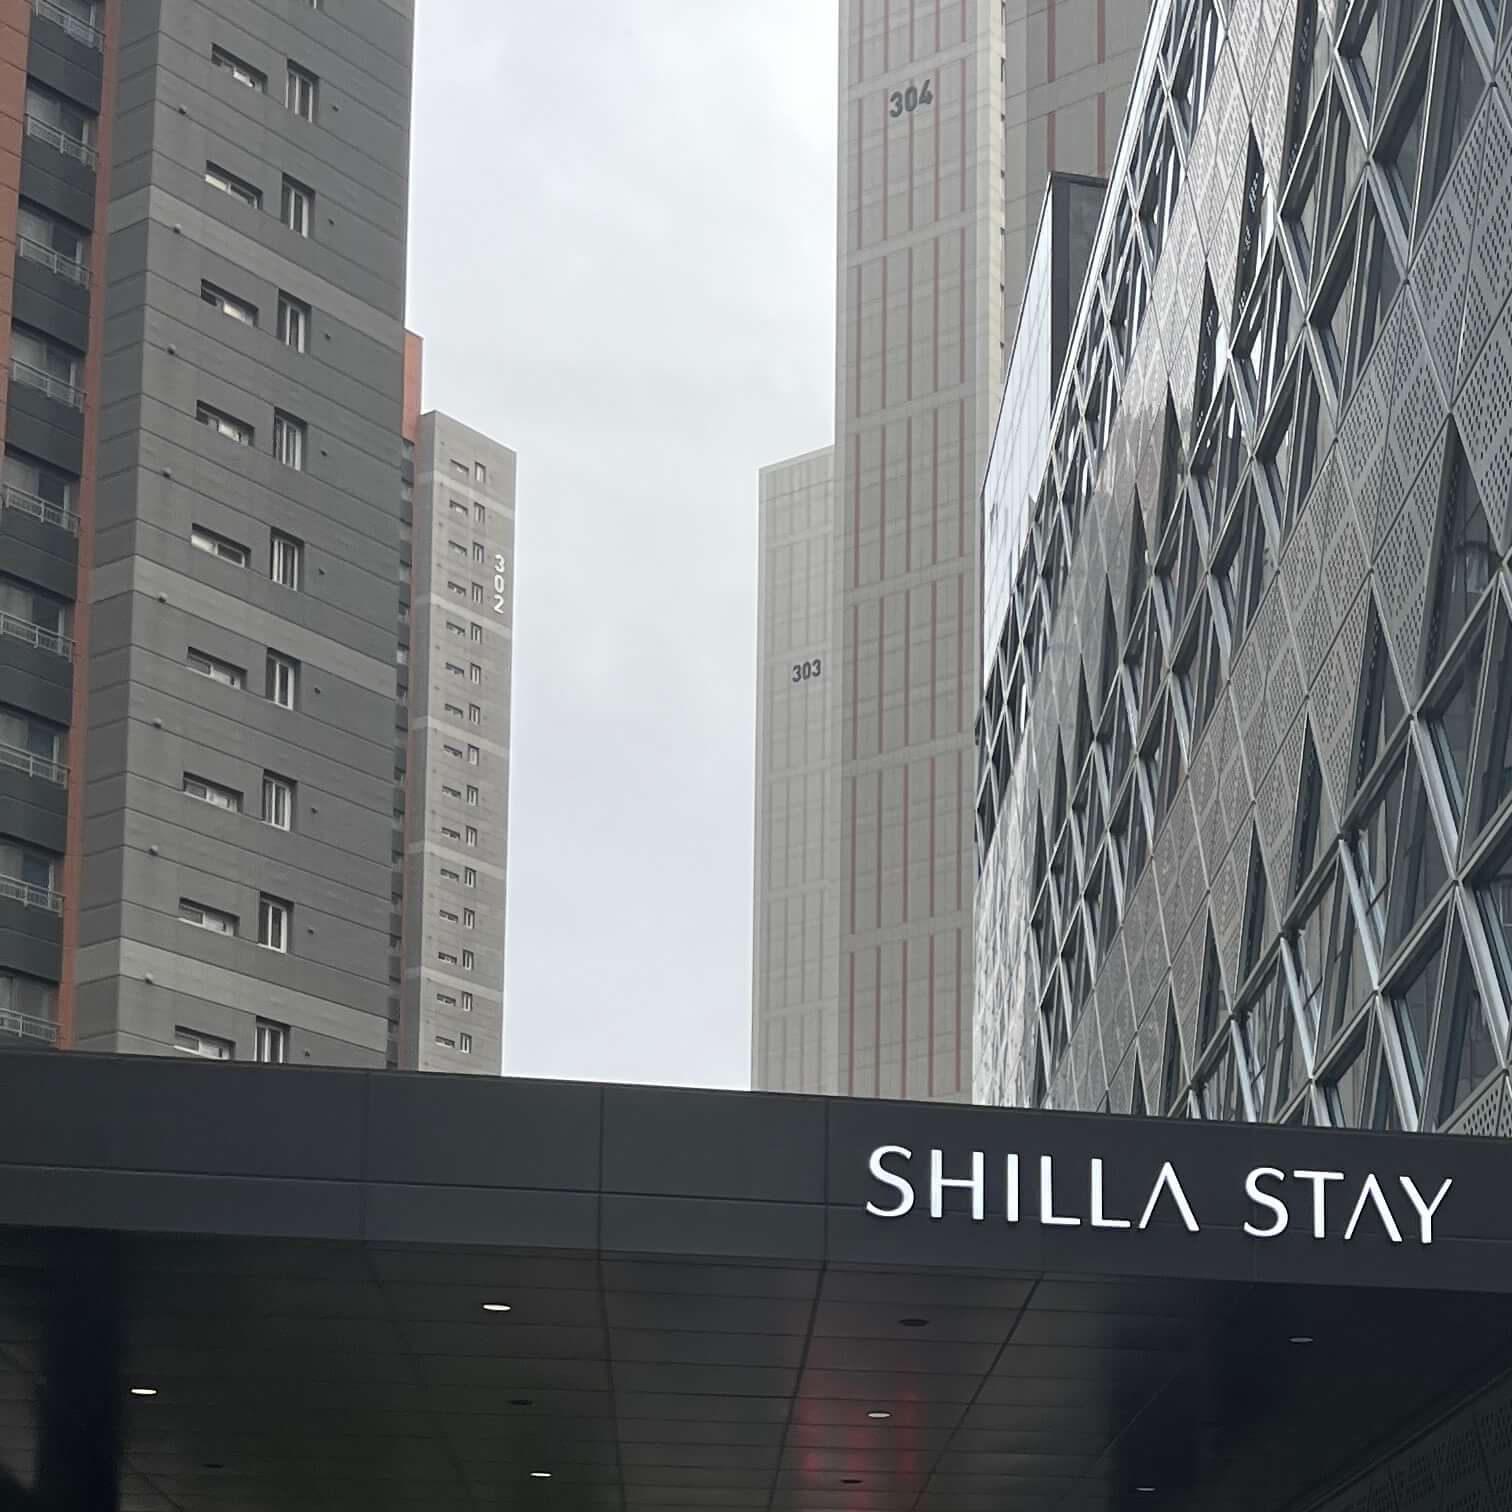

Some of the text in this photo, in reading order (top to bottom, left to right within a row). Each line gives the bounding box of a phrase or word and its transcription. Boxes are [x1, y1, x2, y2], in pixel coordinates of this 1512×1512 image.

[890, 79, 933, 118] 304
[494, 553, 505, 614] 302
[792, 659, 821, 682] 303
[865, 1144, 1453, 1244] SHILLA STAY
